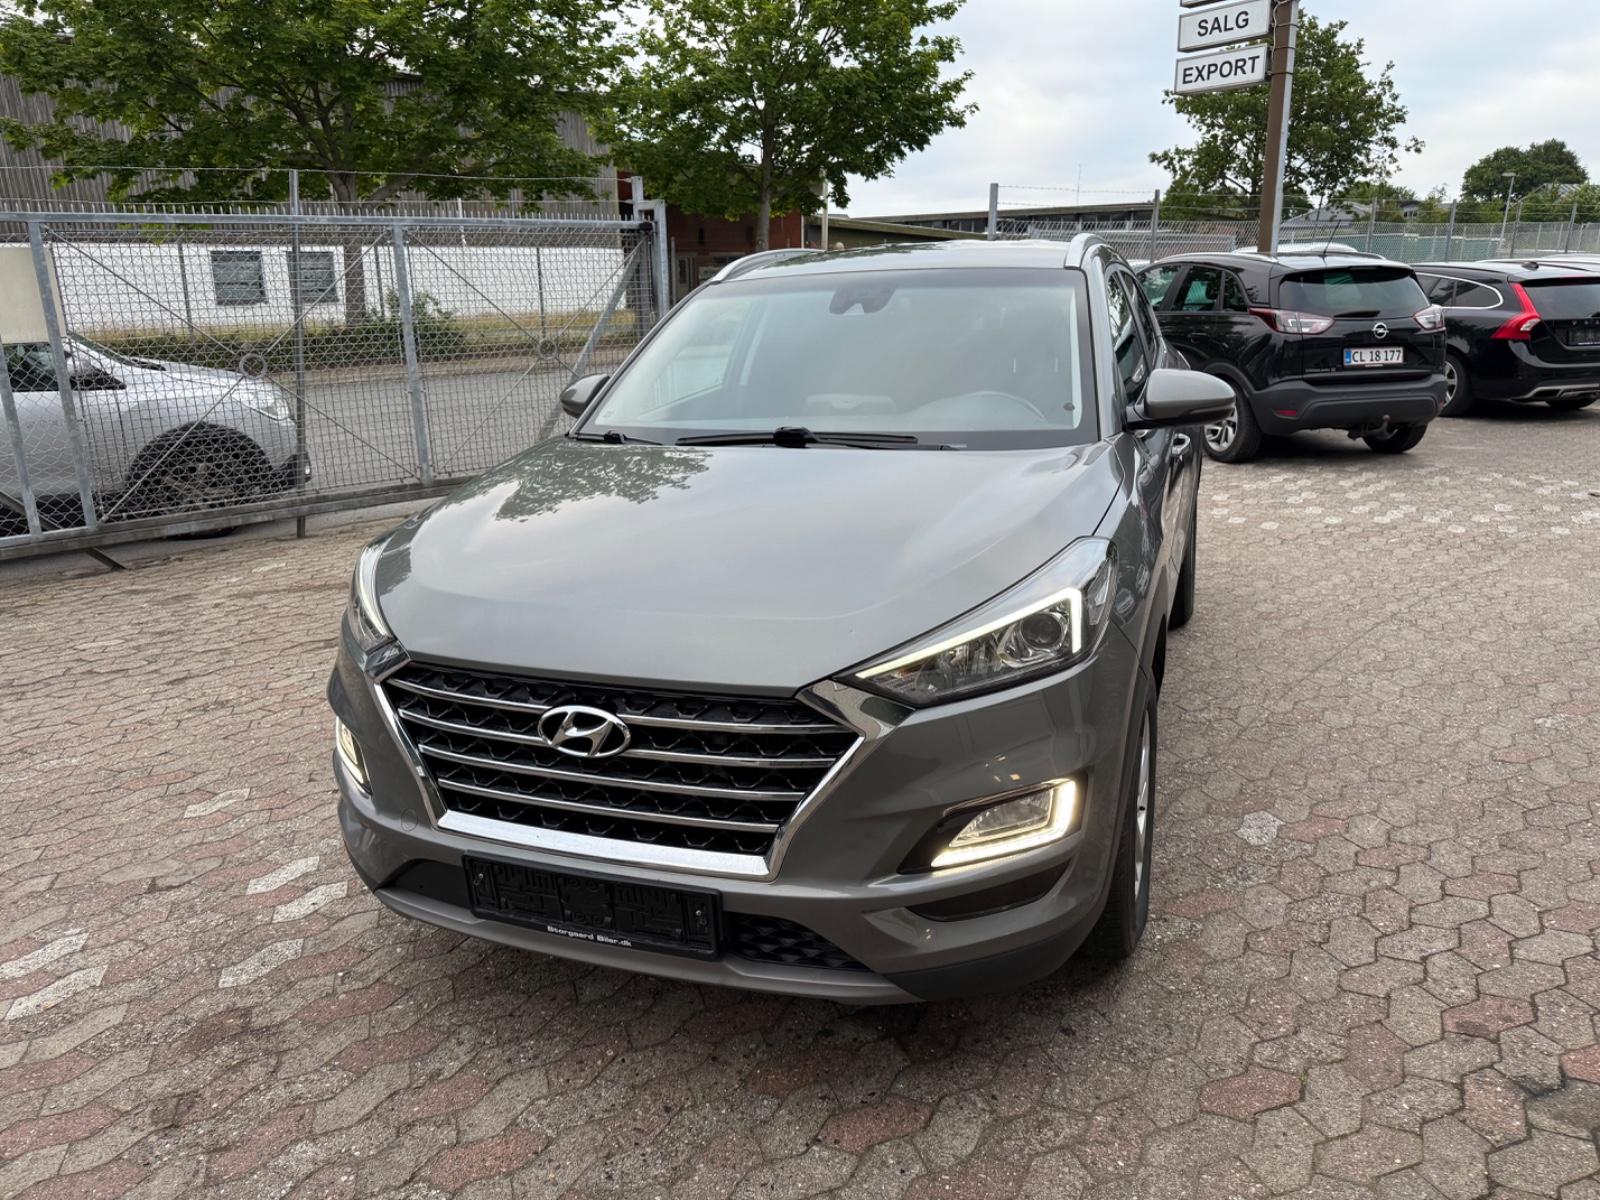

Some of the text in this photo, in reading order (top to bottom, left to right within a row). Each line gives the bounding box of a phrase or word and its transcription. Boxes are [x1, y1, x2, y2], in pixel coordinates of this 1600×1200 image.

[1197, 10, 1249, 37] SALG
[1182, 55, 1260, 84] EXPORT
[1352, 349, 1401, 362] CL 18 177
